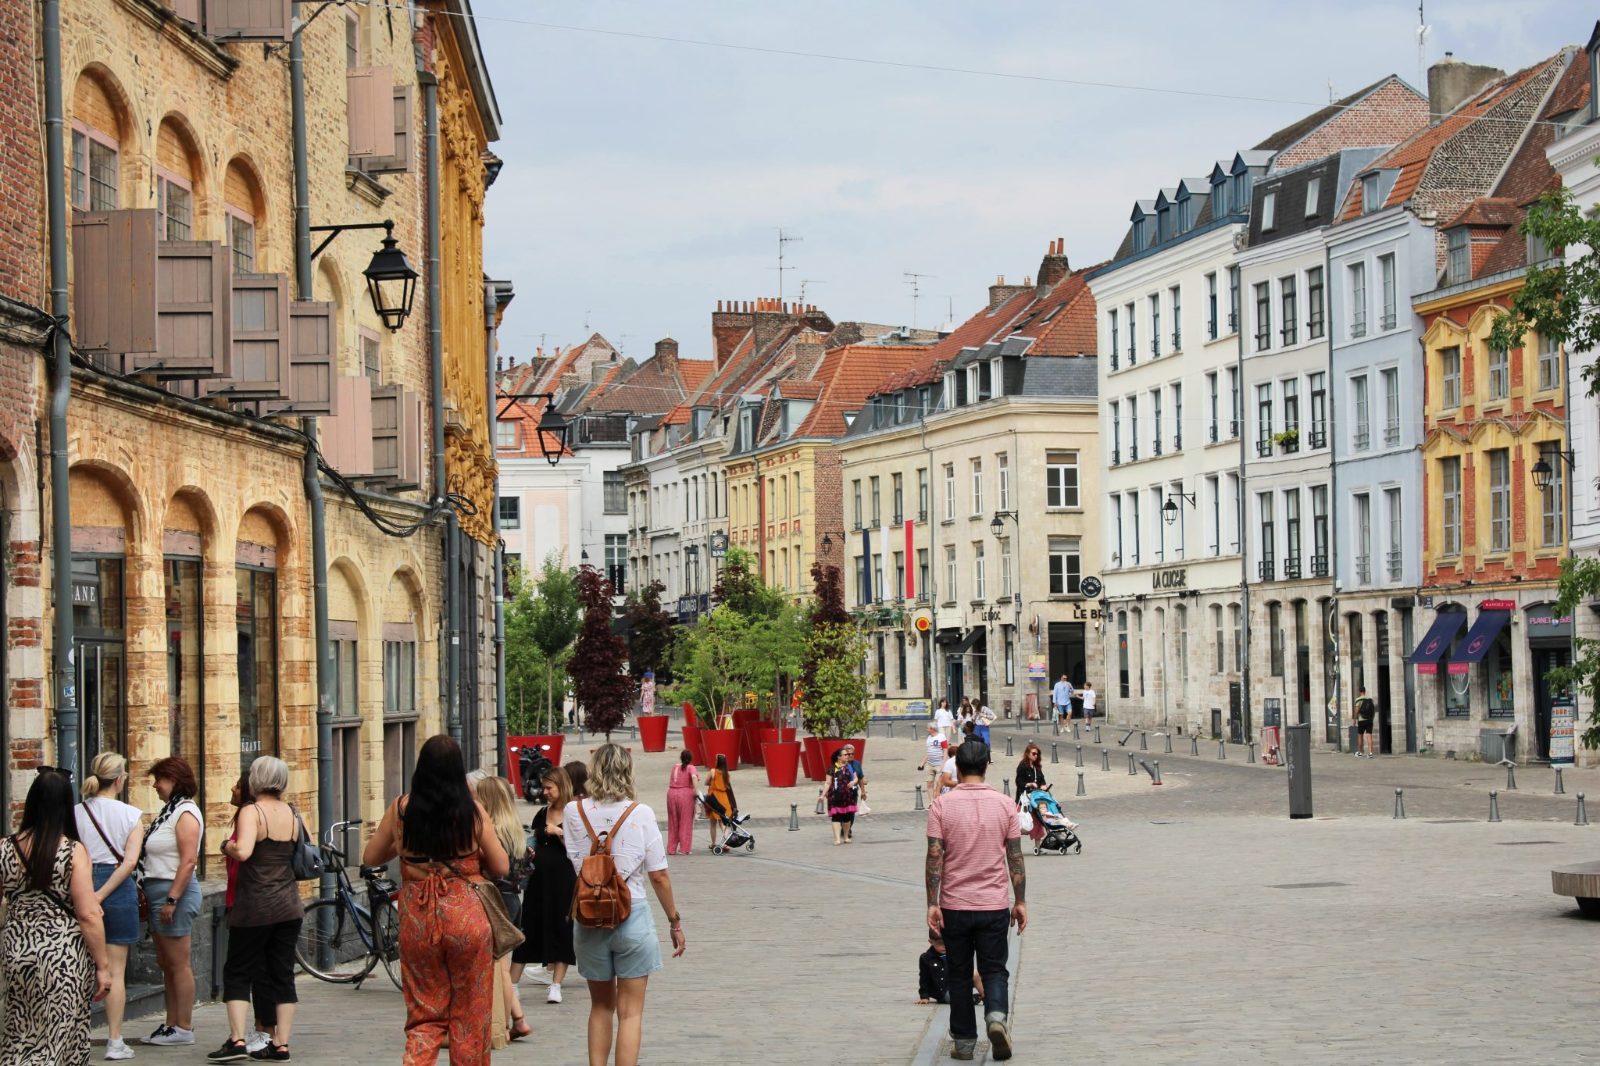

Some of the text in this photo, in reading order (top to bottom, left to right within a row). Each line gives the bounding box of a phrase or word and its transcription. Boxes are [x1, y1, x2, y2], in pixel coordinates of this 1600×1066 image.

[1152, 569, 1186, 588] LA CLIQUE
[981, 611, 988, 622] LE
[1073, 609, 1087, 619] LE
